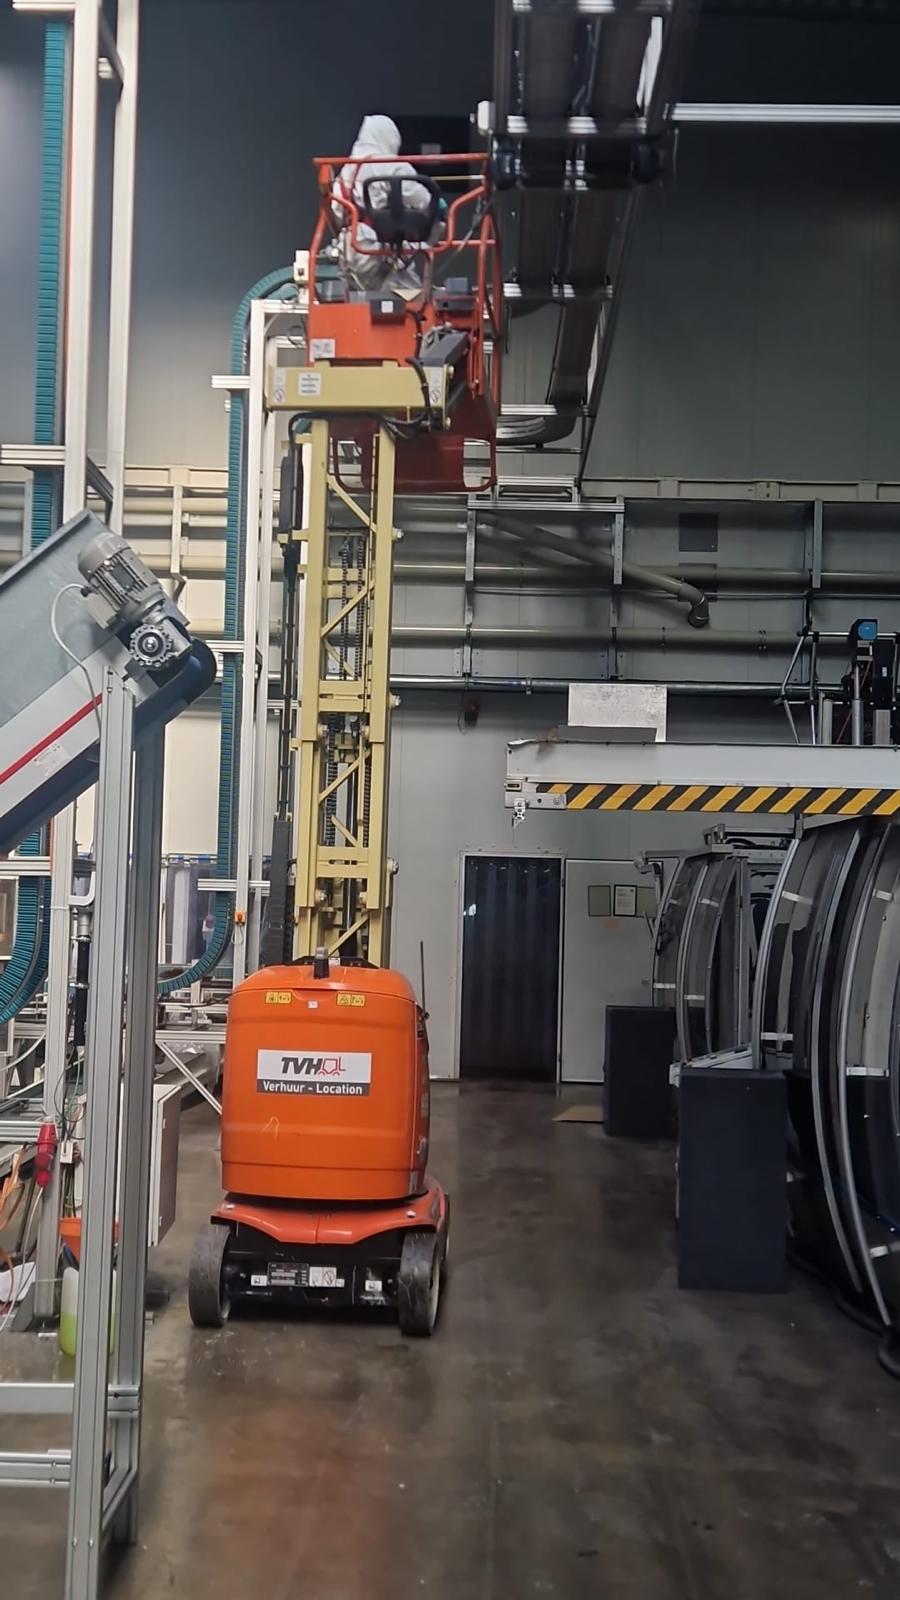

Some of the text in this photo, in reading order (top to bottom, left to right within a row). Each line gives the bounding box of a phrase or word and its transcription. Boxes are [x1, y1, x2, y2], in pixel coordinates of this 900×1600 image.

[281, 1056, 323, 1075] TVH
[263, 1080, 305, 1093] Verhuur
[316, 1082, 363, 1095] Location
